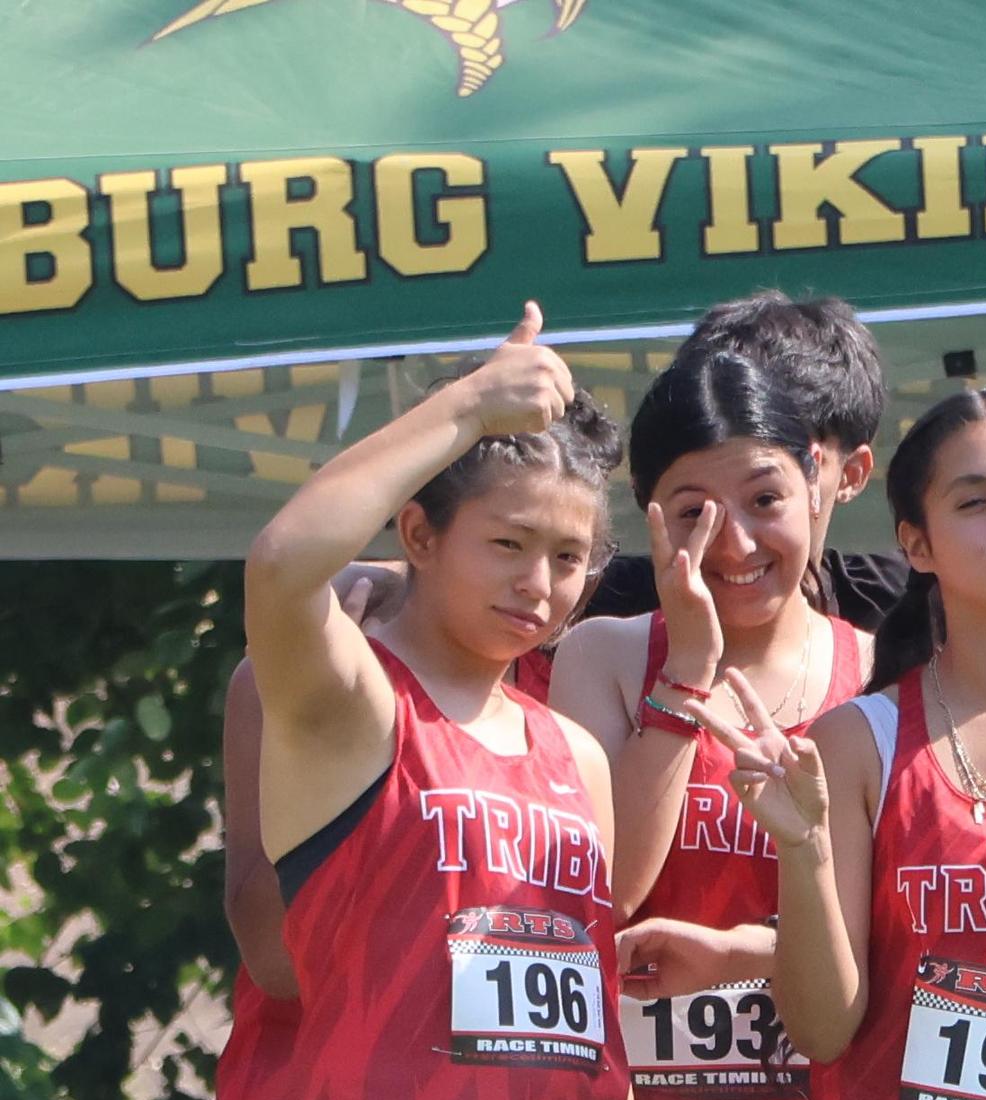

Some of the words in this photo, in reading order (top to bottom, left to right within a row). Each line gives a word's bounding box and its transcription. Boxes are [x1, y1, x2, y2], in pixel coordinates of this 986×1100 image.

[0, 152, 491, 316] BURG
[420, 788, 613, 908] TRIB
[487, 911, 576, 940] RTS
[485, 960, 588, 1034] 196
[642, 994, 778, 1061] 193
[475, 1038, 537, 1053] RACE
[539, 1039, 597, 1062] TIMING
[635, 1071, 699, 1086] RACE
